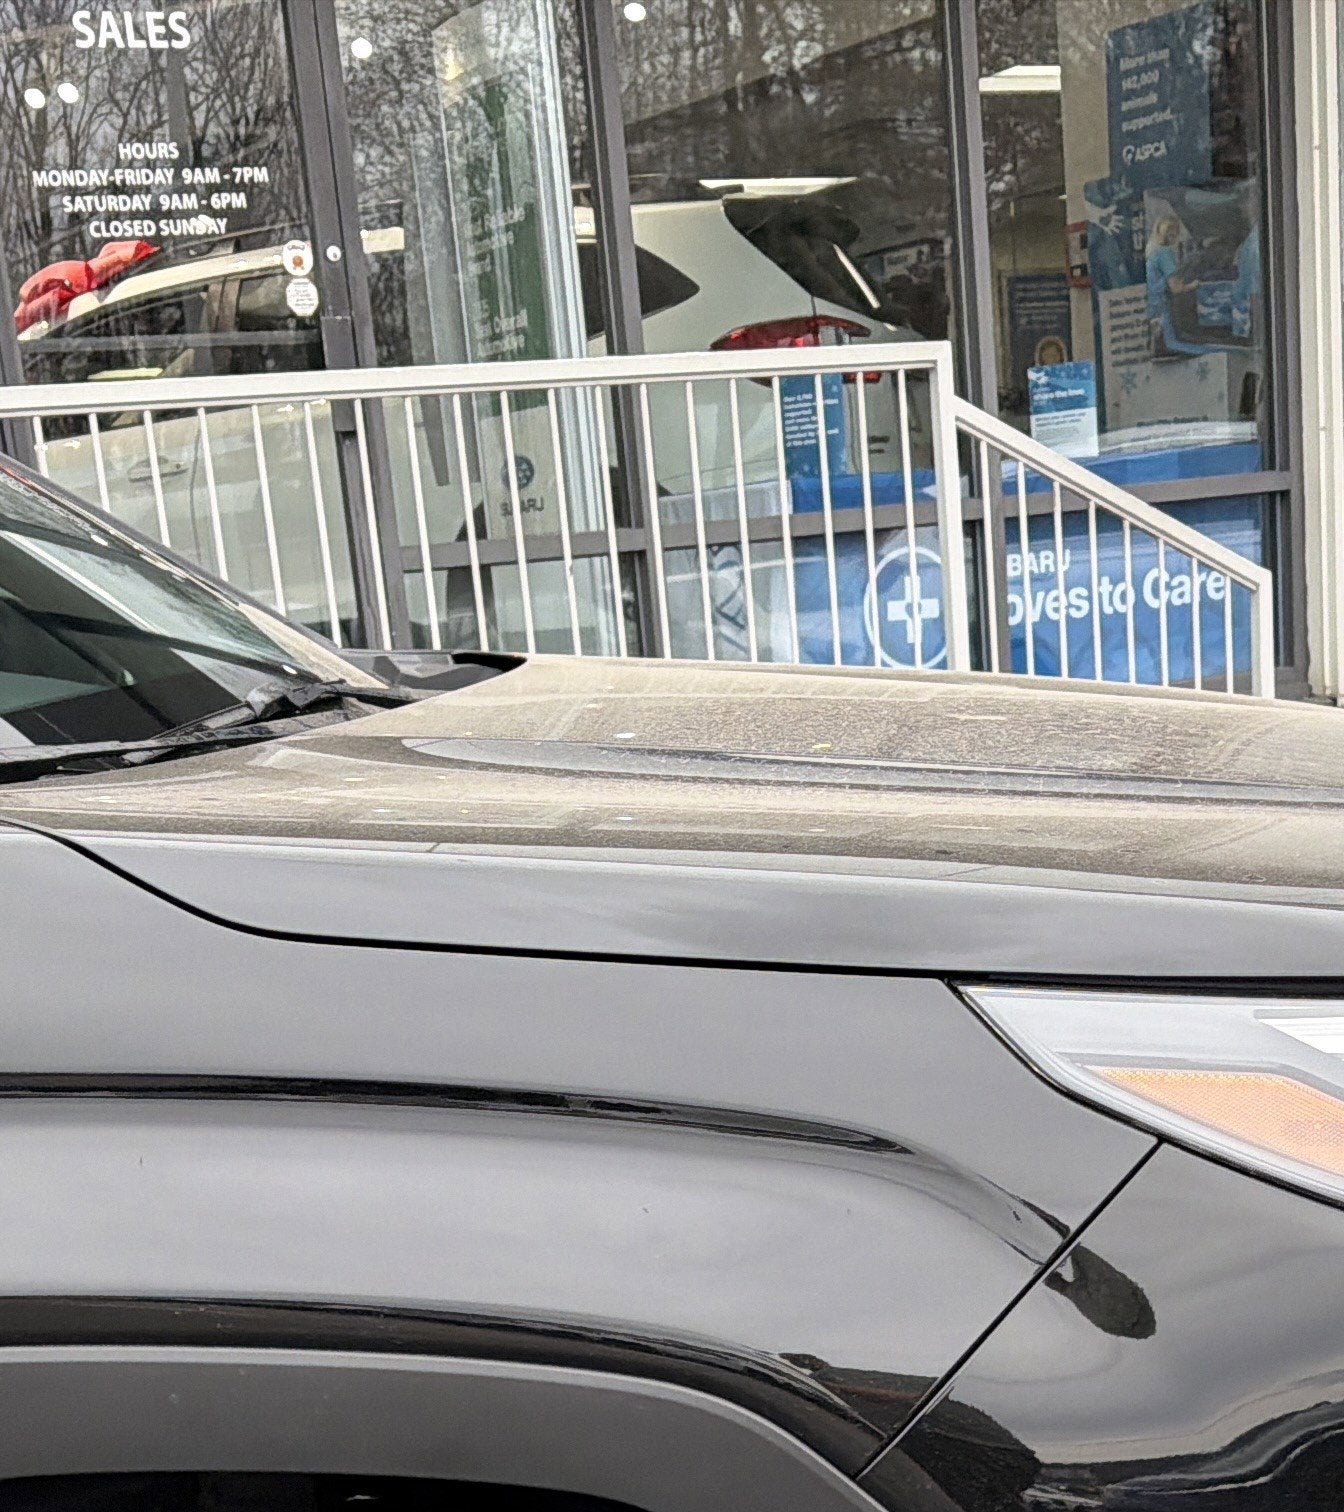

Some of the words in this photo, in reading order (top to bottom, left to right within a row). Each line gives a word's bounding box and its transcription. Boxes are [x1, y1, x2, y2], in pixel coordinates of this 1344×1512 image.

[72, 10, 191, 49] SALES
[118, 142, 179, 159] HOURS
[32, 168, 175, 187] MONDAY-FRIDAY
[182, 167, 221, 185] 9AM
[232, 166, 269, 183] 7PM
[62, 194, 152, 213] SATURDAY
[159, 193, 198, 211] 9AM
[210, 192, 248, 209] 6PM
[89, 220, 156, 238] CLOSED
[500, 497, 544, 516] SUARU
[1006, 549, 1070, 577] BARU
[1007, 586, 1090, 626] oves
[1100, 575, 1135, 614] to
[1143, 567, 1226, 609] Care
